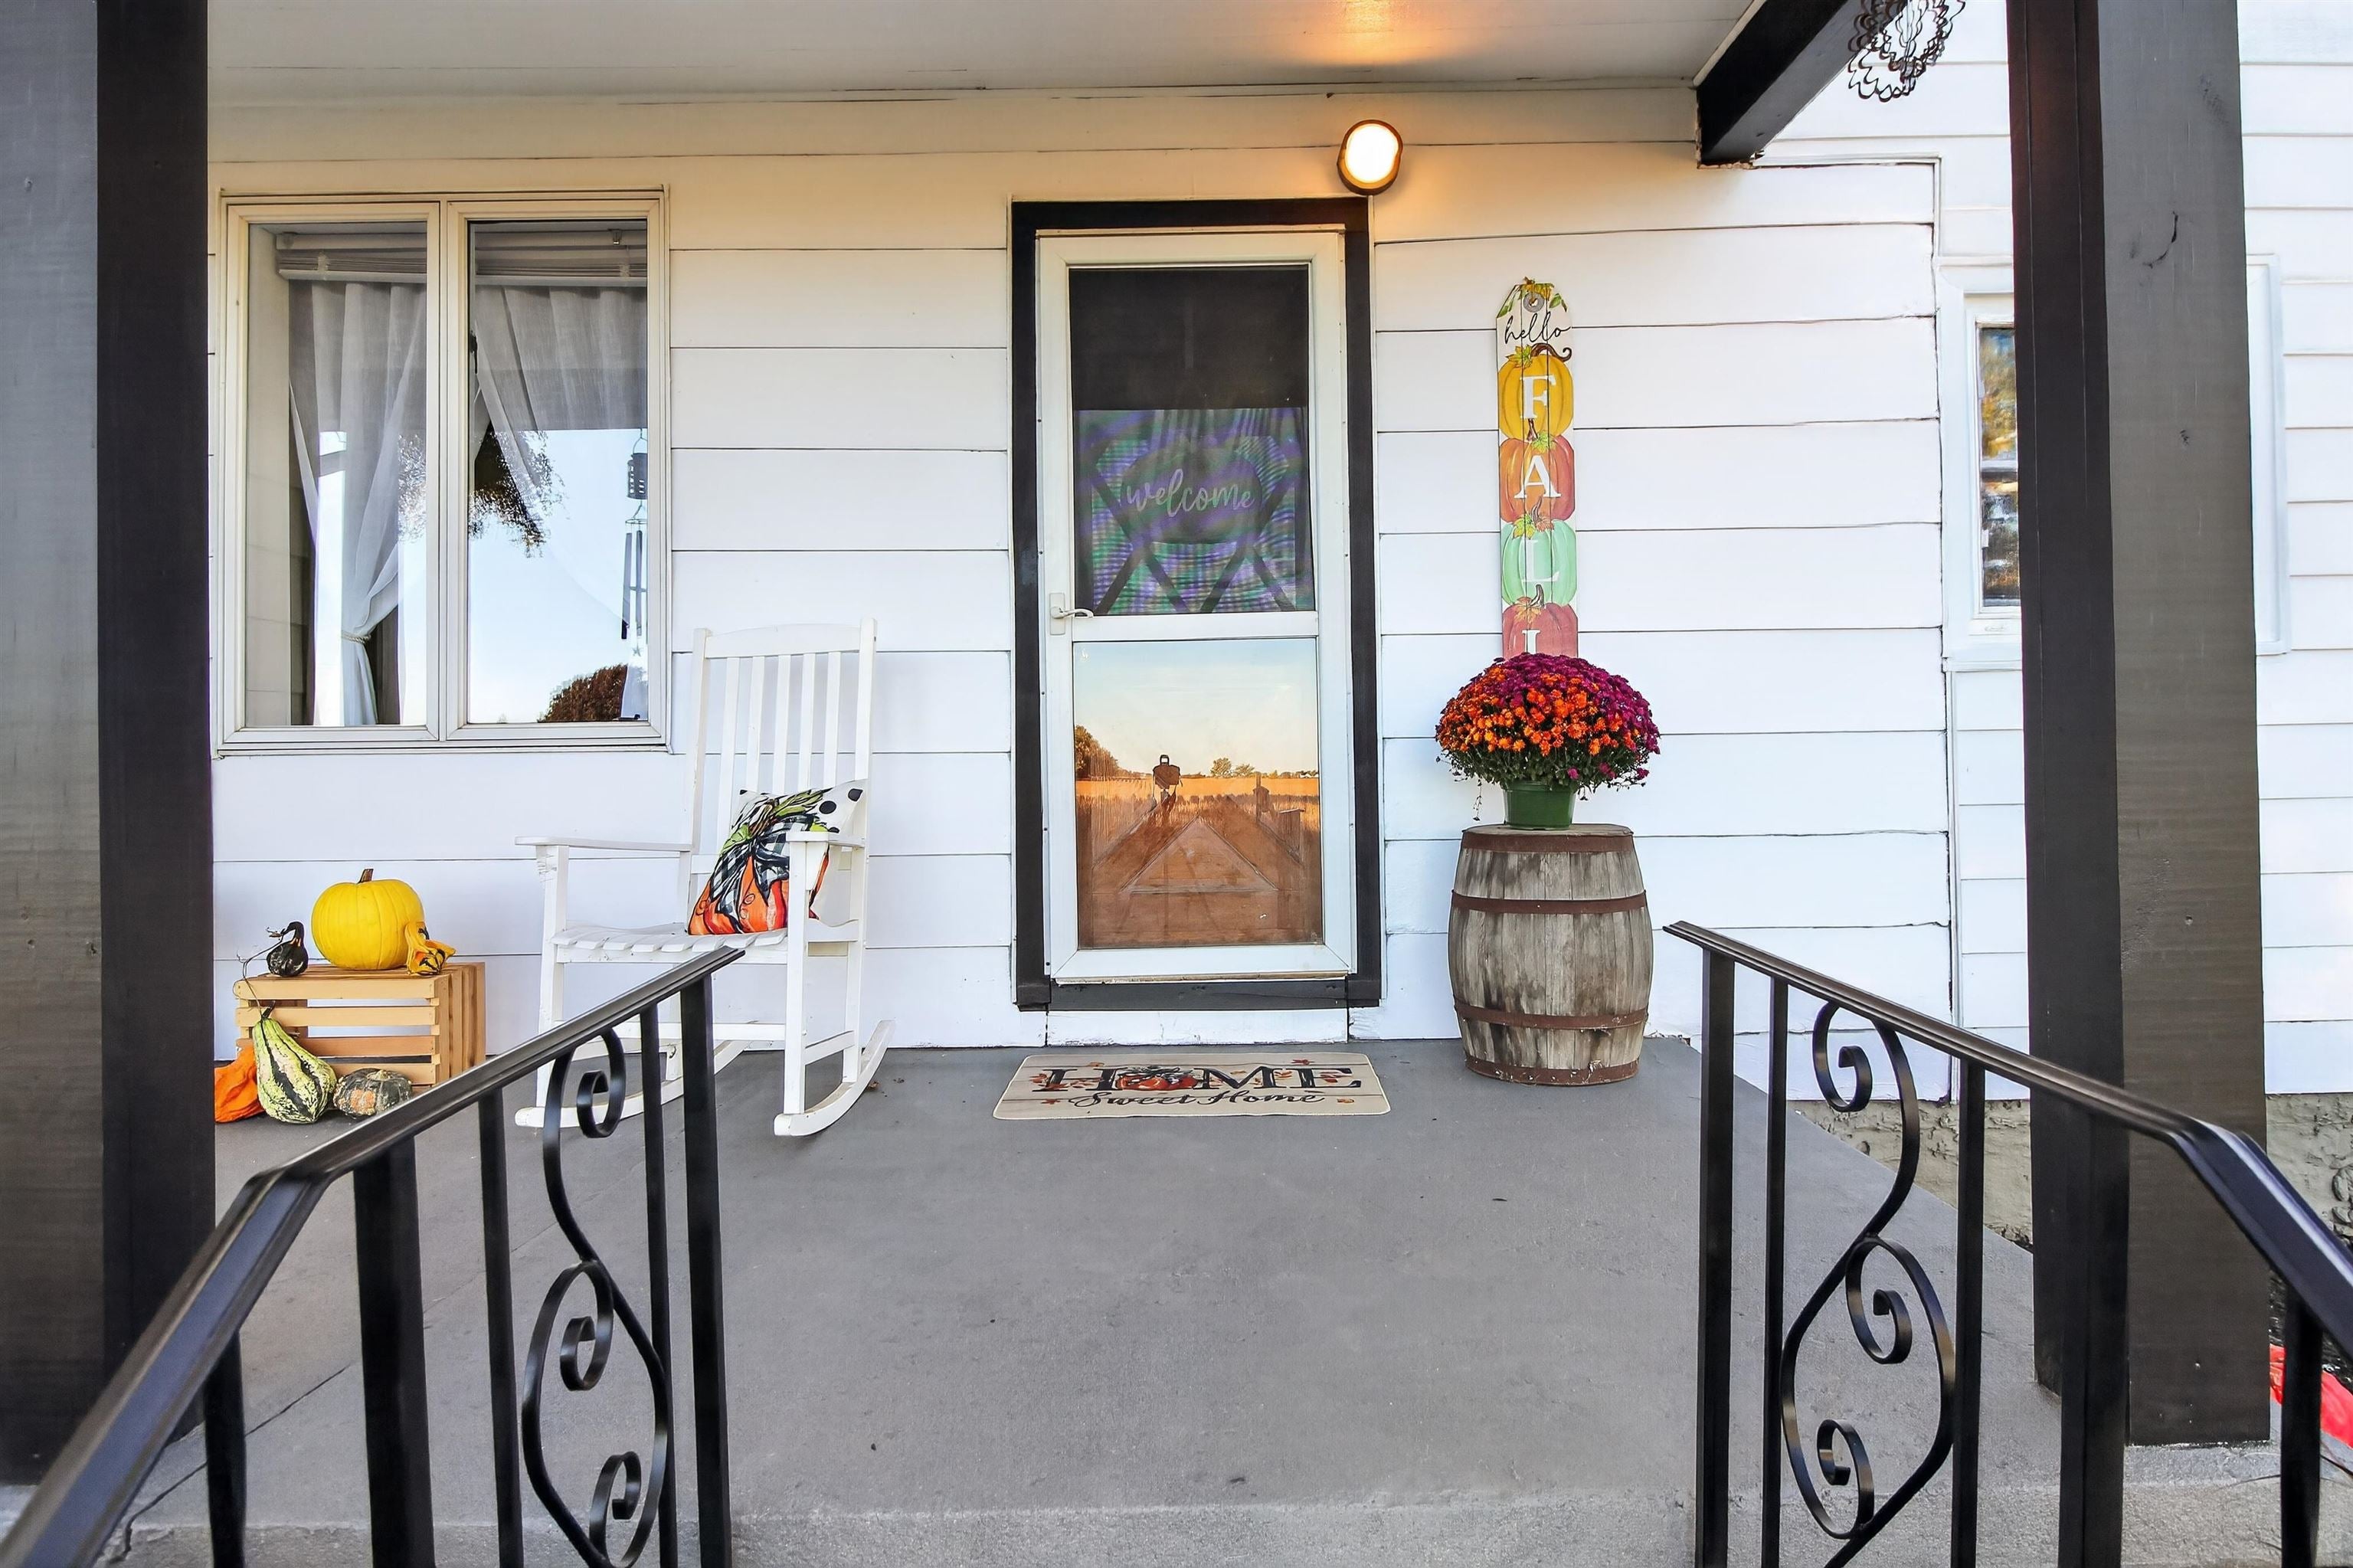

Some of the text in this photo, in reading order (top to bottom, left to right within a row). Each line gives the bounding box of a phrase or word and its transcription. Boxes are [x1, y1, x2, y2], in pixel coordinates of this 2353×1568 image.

[1504, 311, 1571, 344] hello
[1126, 469, 1255, 517] welcome
[1069, 1090, 1325, 1108] Sweet Home
